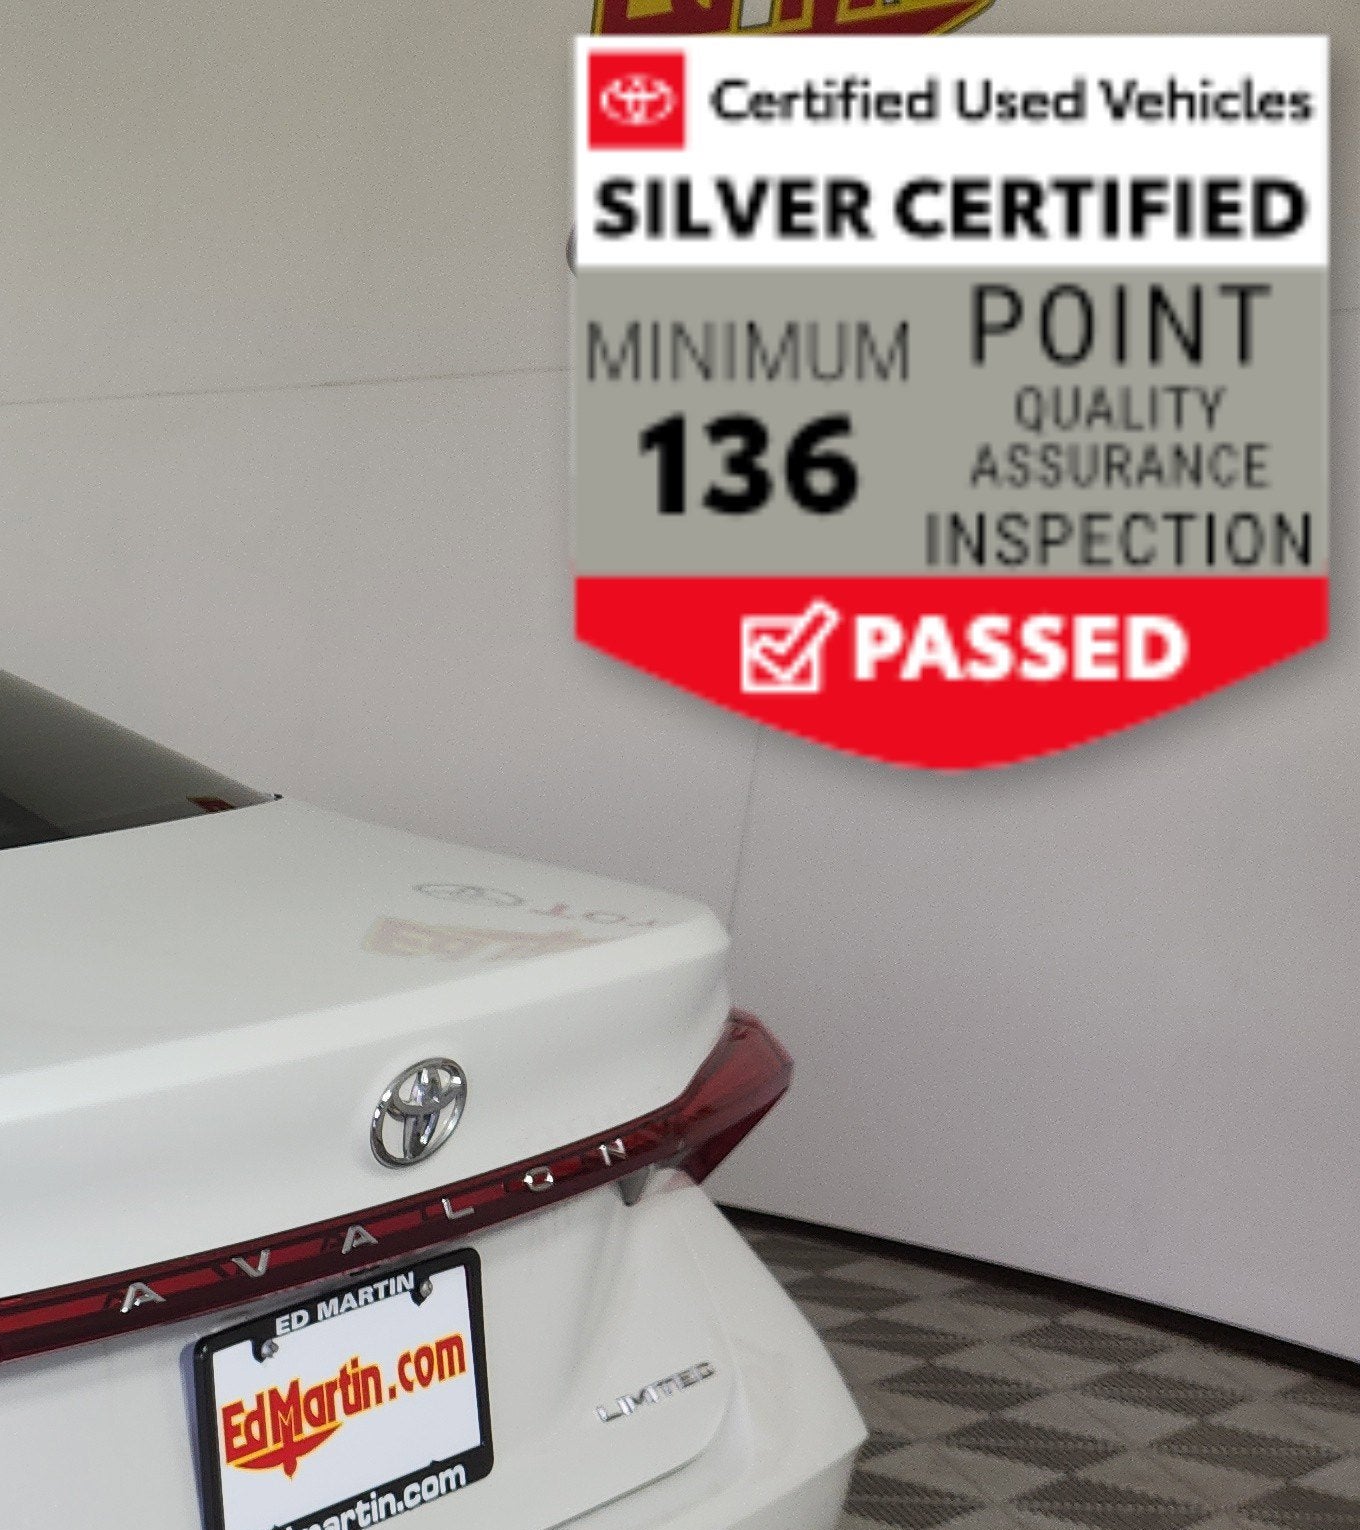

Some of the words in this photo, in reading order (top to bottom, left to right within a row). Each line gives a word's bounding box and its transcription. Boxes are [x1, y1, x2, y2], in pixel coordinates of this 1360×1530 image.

[119, 1138, 627, 1314] AVALON
[275, 1308, 310, 1338] ED
[316, 1271, 416, 1321] MARTIN
[221, 1332, 468, 1472] EdMartin.com
[593, 1360, 716, 1423] LIMITED
